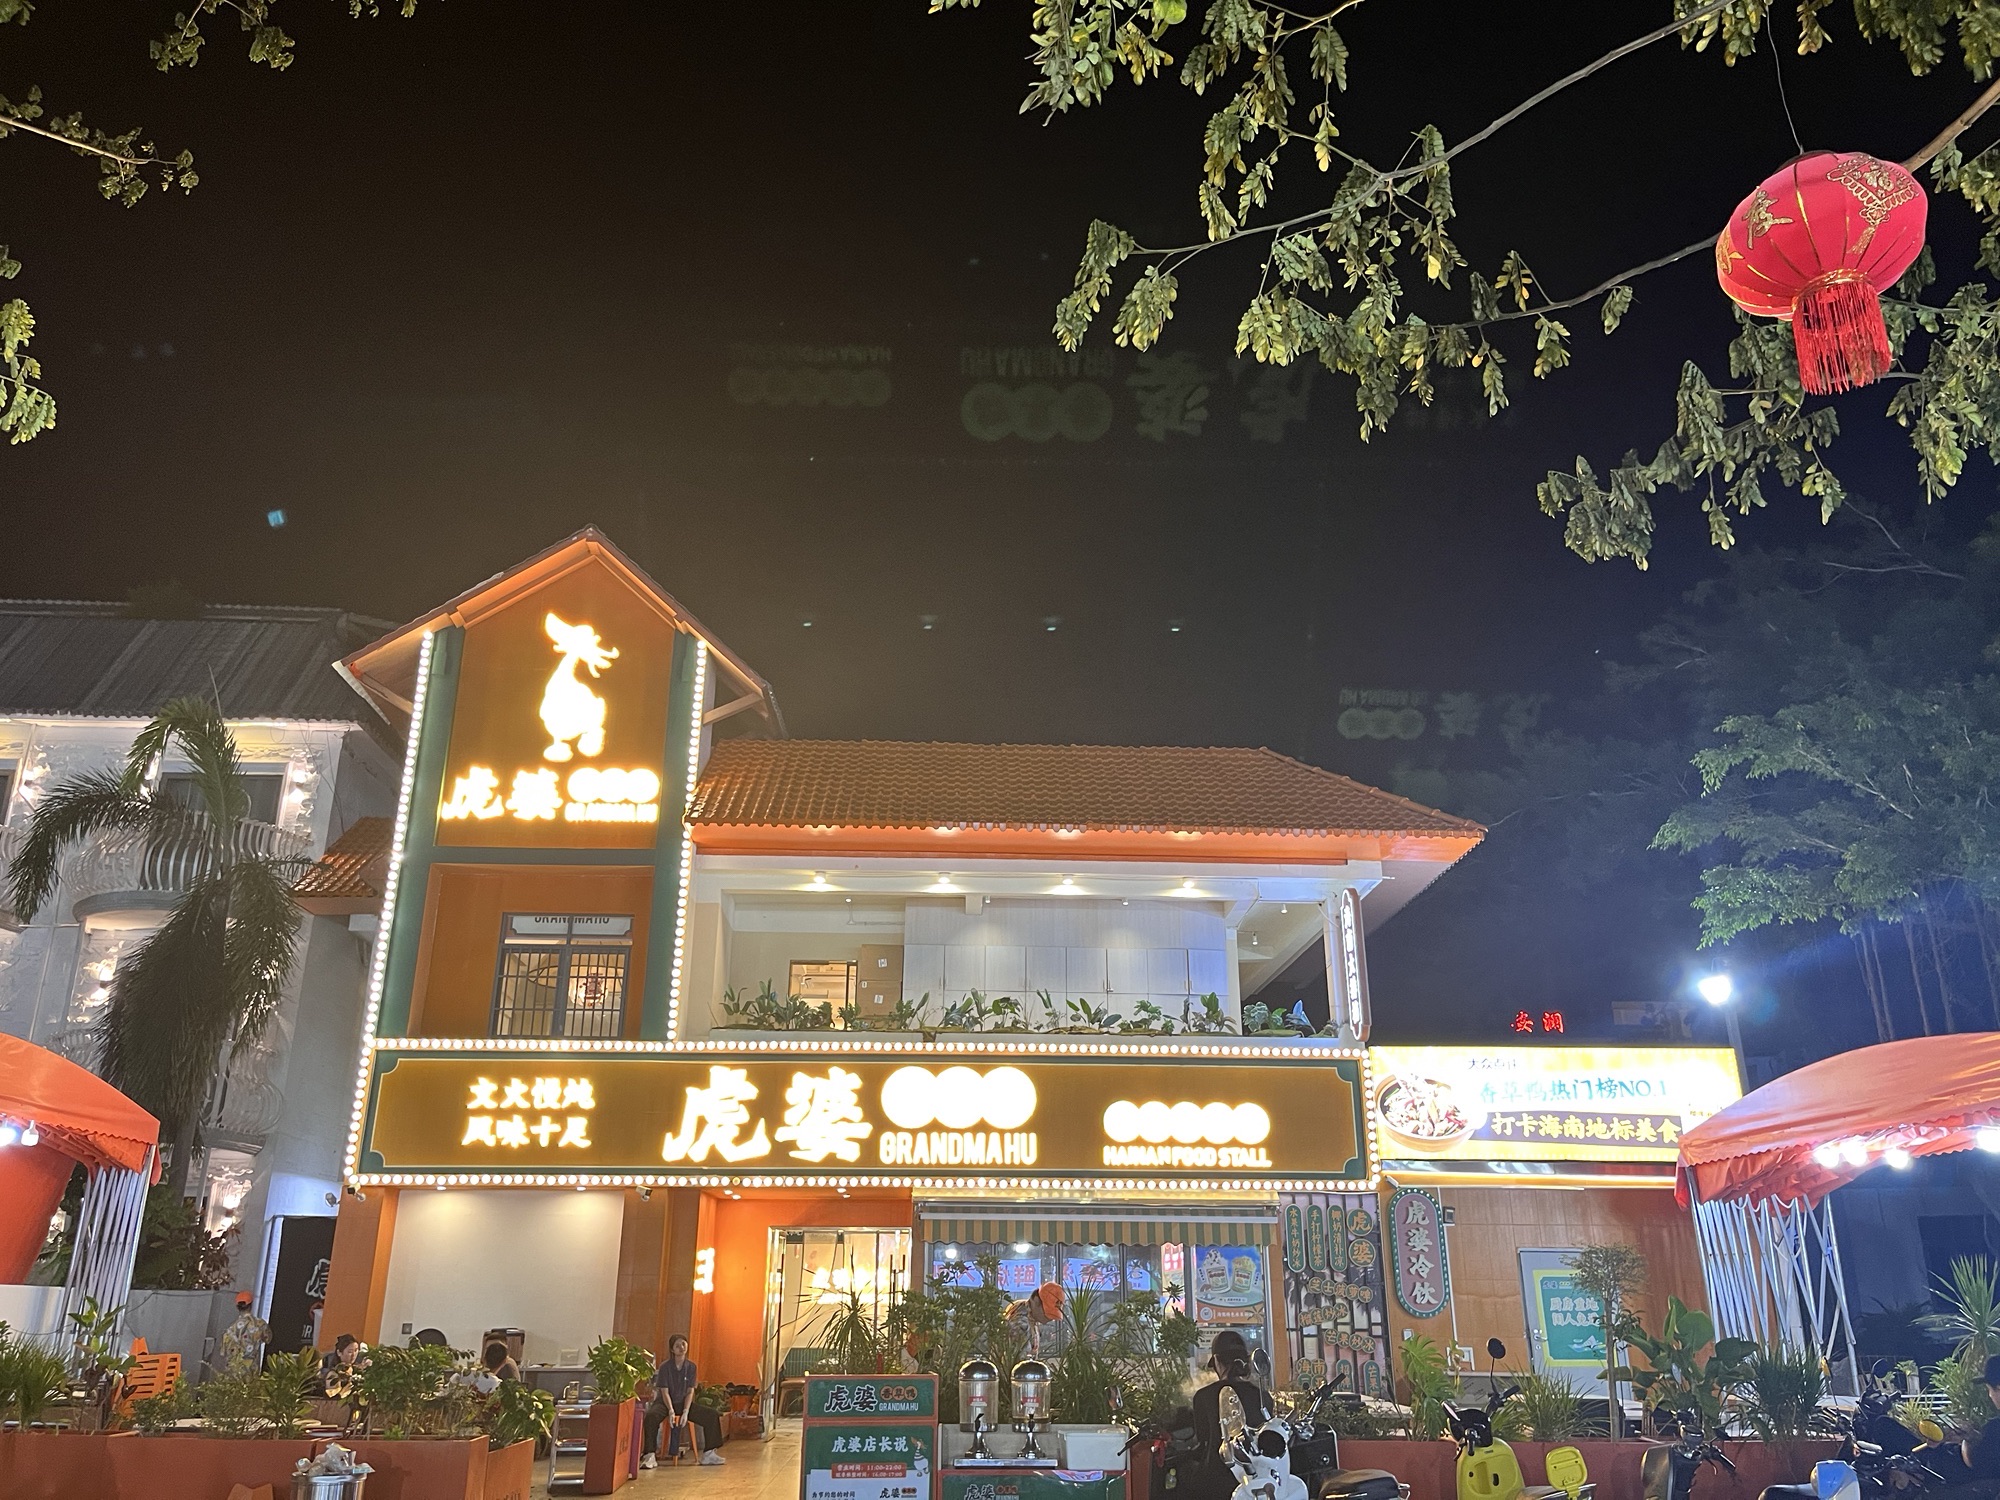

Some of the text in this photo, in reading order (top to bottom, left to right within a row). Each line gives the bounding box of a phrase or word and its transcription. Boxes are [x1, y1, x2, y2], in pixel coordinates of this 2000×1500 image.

[662, 1065, 873, 1163] 虎婆
[1491, 1112, 1681, 1144] 打卡海南地标美食
[461, 1114, 592, 1149] 风味十足
[1103, 1145, 1272, 1168] HAINAN FOOD STALL
[1310, 1209, 1323, 1267] 手打柠檬茶
[1350, 1211, 1374, 1264] 虎婆
[1405, 1200, 1439, 1305] 虎婆冷饮
[1550, 1297, 1600, 1312] 厨房重地
[1325, 1329, 1376, 1352] 芒果炒冰
[1298, 1359, 1326, 1375] 海南
[824, 1384, 878, 1413] 虎婆
[881, 1386, 917, 1400] 香草鸭
[831, 1435, 909, 1453] 虎婆店长说
